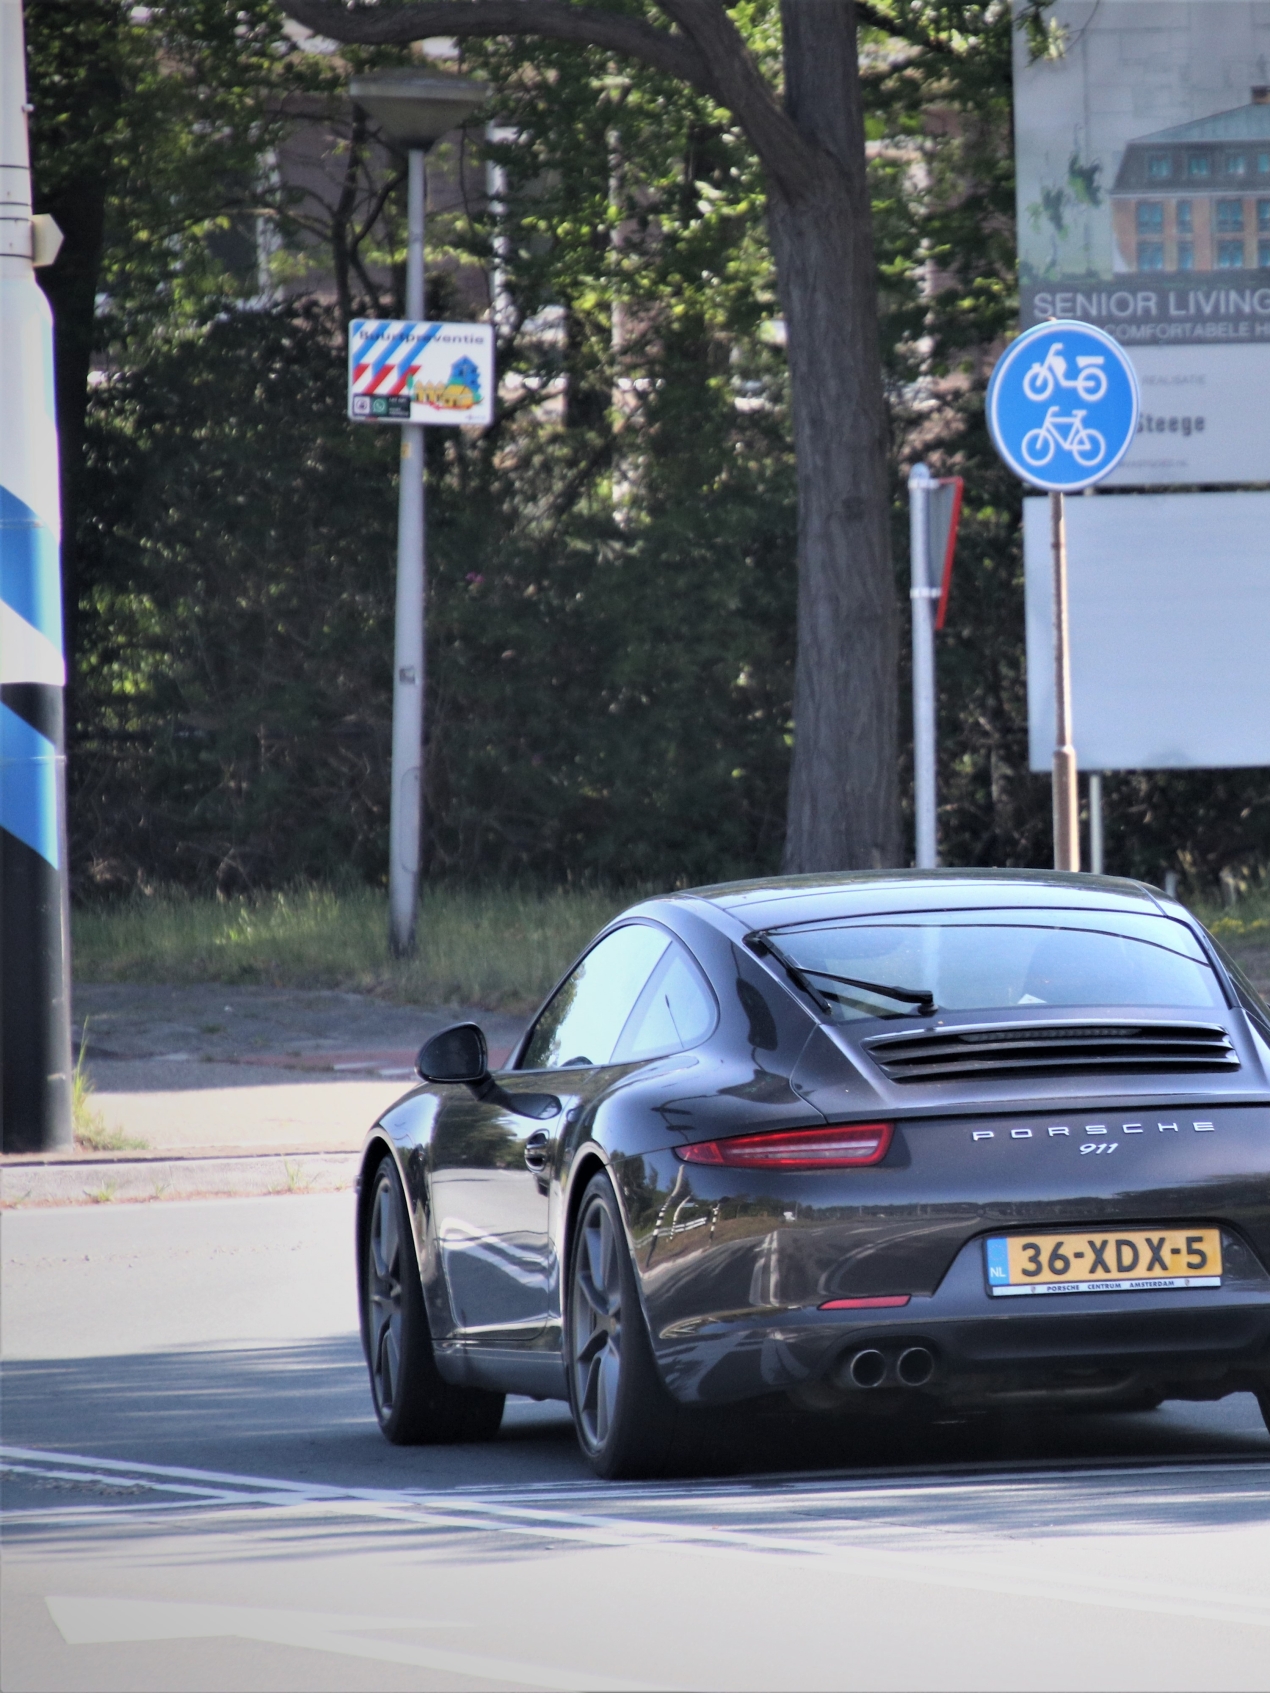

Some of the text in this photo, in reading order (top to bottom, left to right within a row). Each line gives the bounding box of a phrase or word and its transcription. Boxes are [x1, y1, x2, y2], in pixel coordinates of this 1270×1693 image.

[1034, 291, 1158, 318] SENIOR
[359, 330, 485, 344] Buurtpreventie
[1104, 322, 1250, 340] COMFORTABELE
[972, 1121, 1215, 1141] PORSCHE
[1079, 1143, 1119, 1155] 911
[990, 1236, 1208, 1278] NL 36-XDX-5
[1047, 1284, 1080, 1292] PORSCHE
[1129, 1280, 1175, 1289] AMSTERDAM
